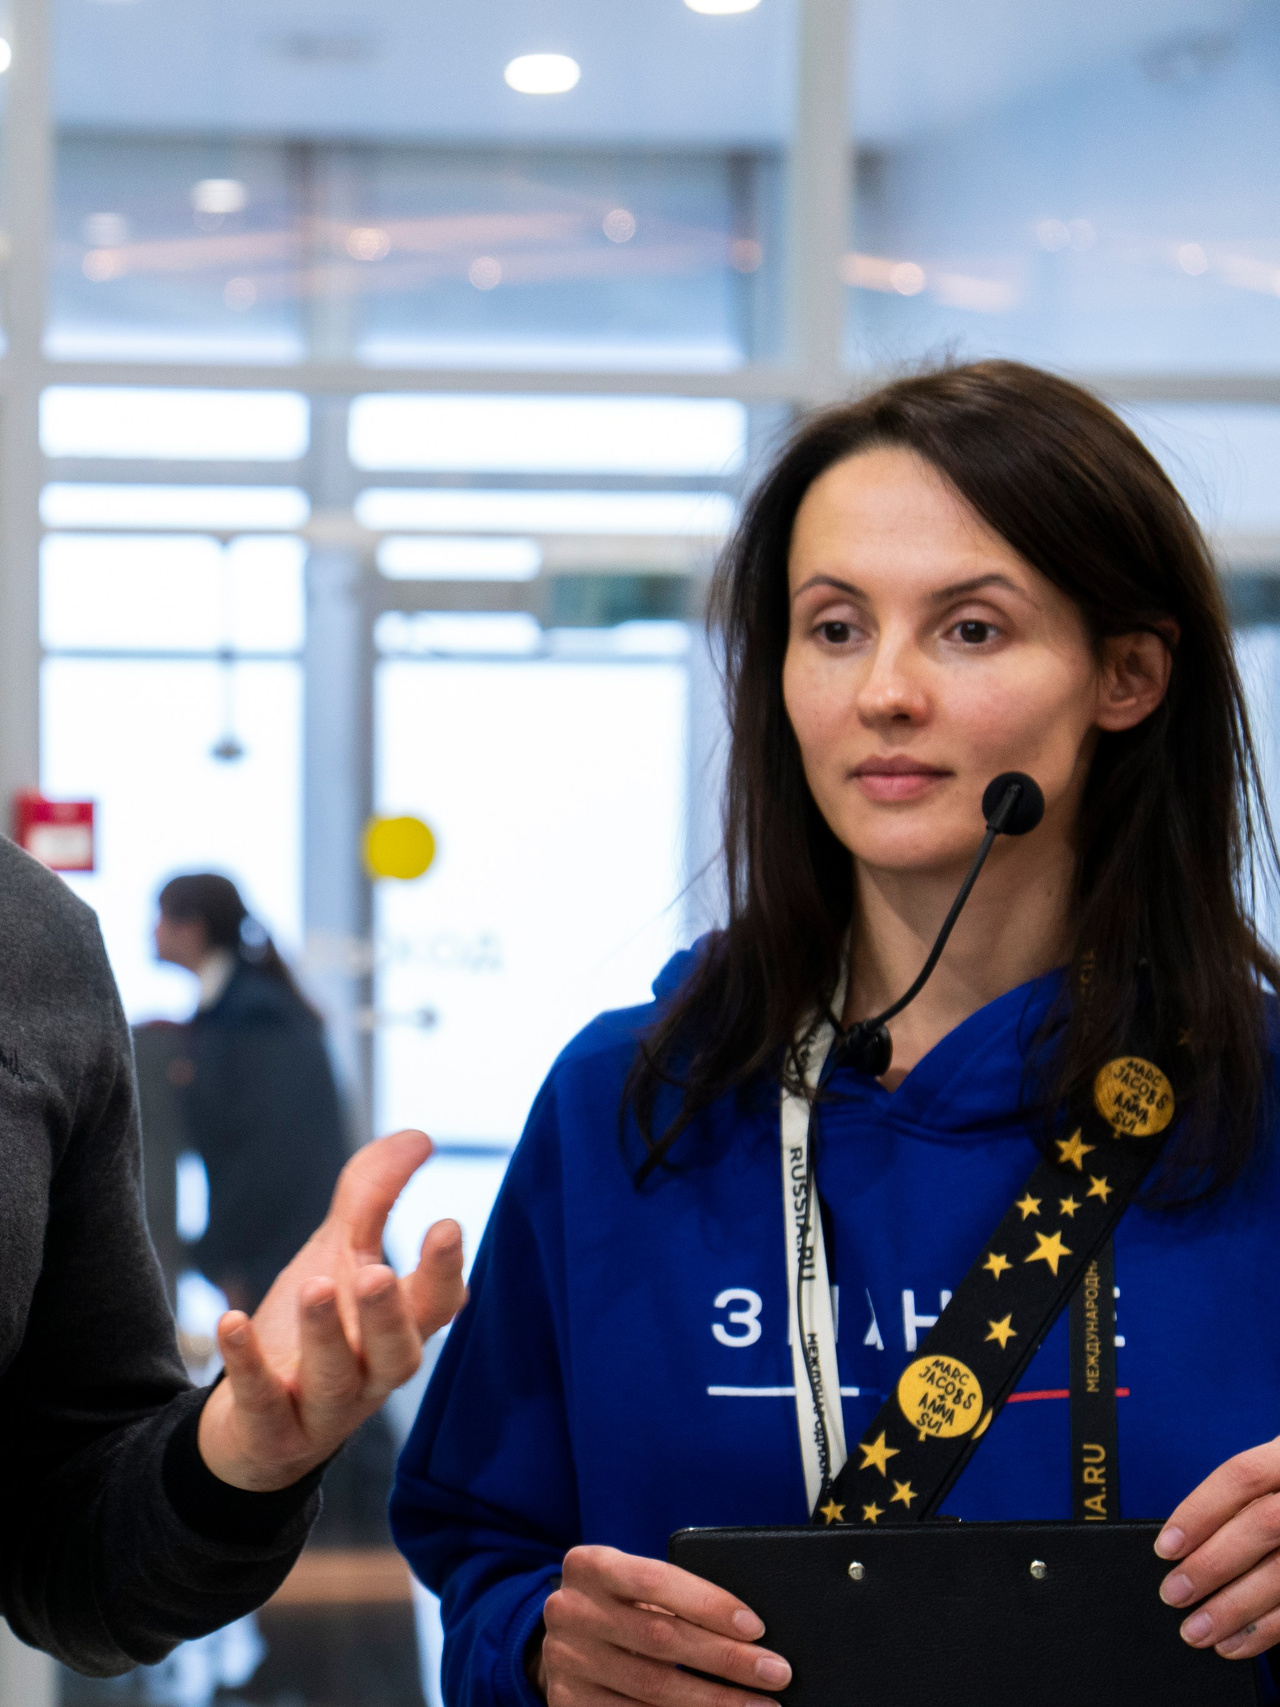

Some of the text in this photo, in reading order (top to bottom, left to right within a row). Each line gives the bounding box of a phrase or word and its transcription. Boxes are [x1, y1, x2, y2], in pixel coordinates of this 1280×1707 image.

[1114, 1091, 1148, 1125] ANNA
[1084, 1260, 1101, 1393] МЕЖДУНАРОДН
[919, 1365, 977, 1410] JACOBS
[932, 1359, 970, 1386] MARC
[916, 1412, 943, 1434] SUI
[918, 1392, 955, 1426] ANNA
